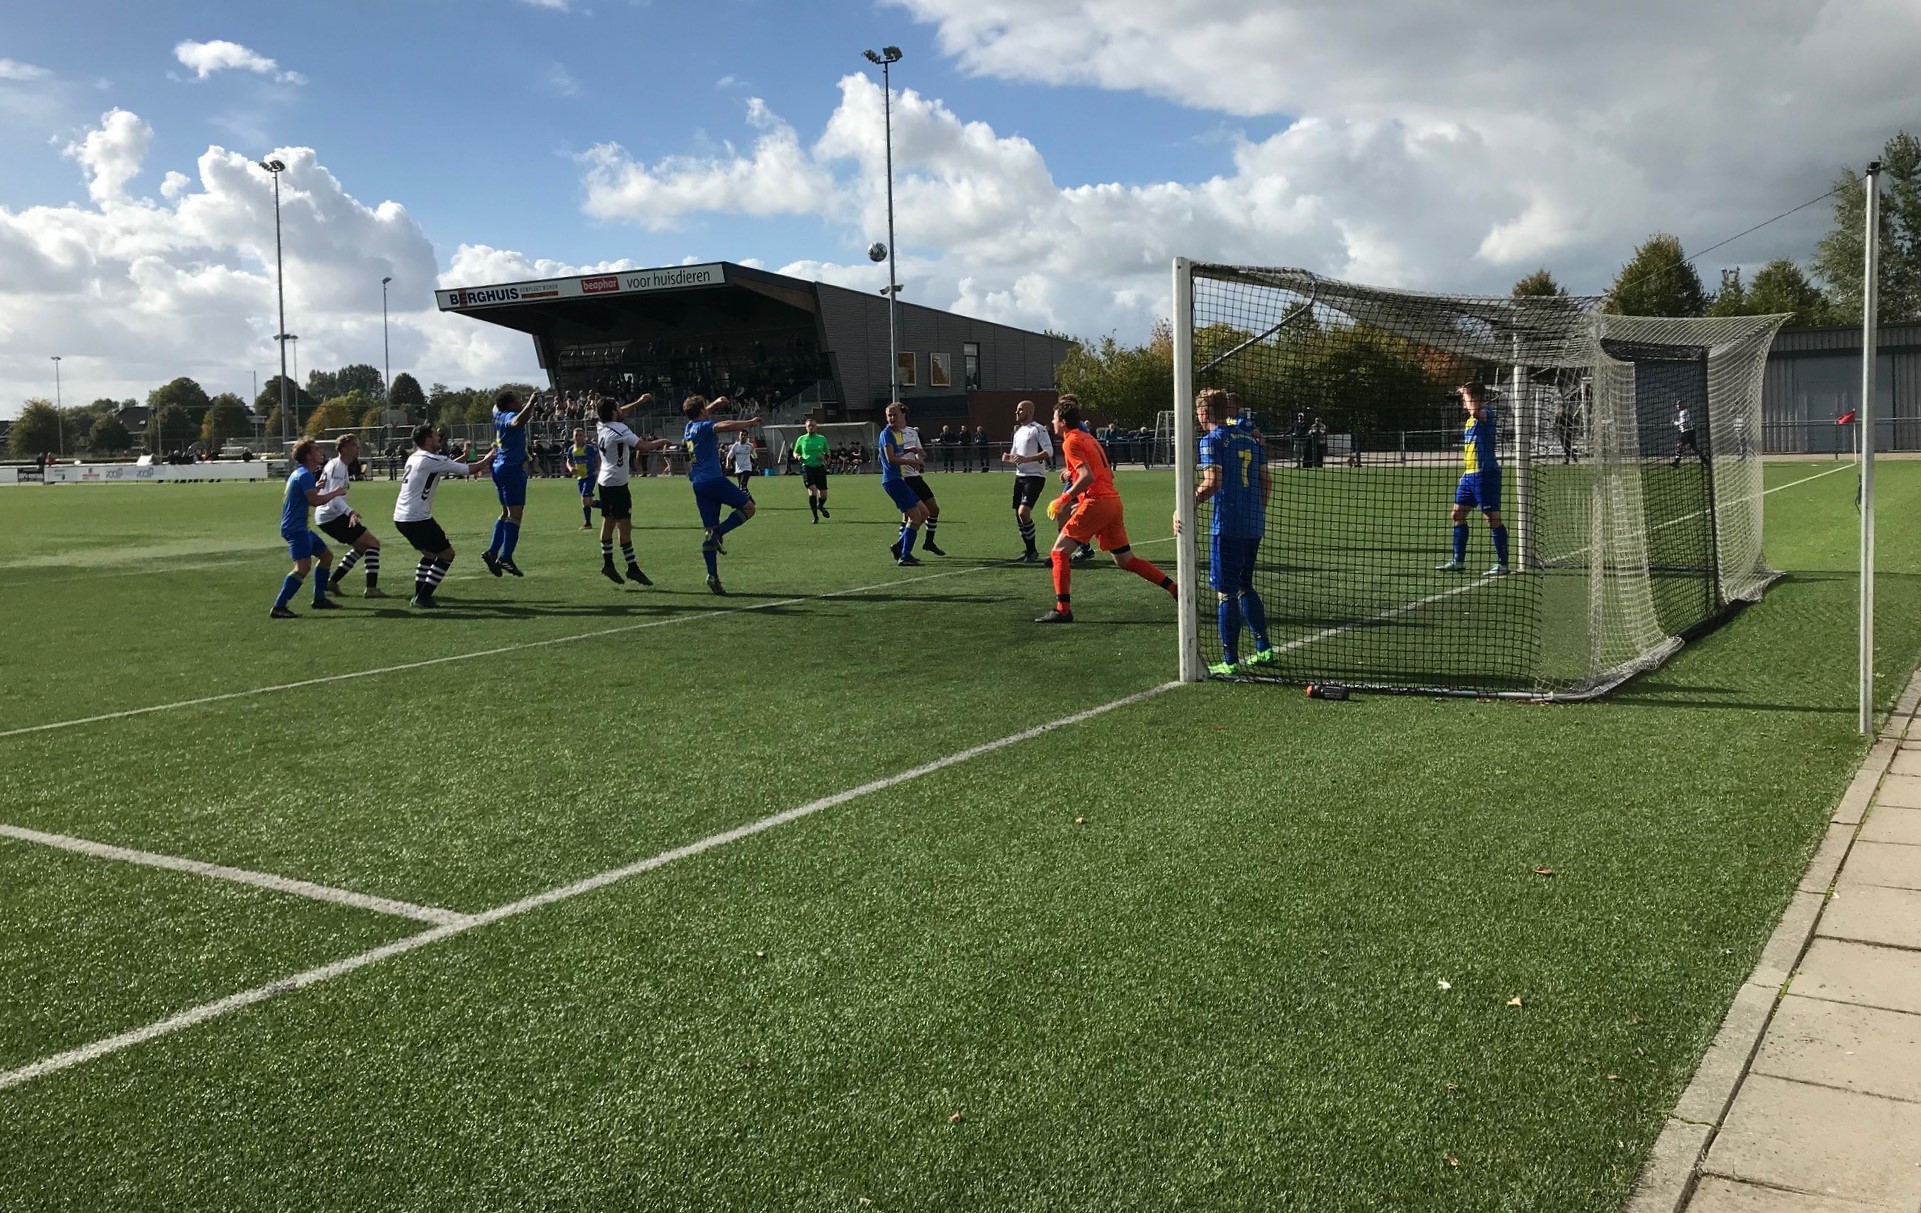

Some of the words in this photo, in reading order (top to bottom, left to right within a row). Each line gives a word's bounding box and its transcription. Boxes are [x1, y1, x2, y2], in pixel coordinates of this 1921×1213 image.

[582, 278, 617, 291] beaphar
[627, 276, 651, 289] voor
[653, 270, 711, 286] huisdieren
[449, 287, 520, 305] BERGHUIS
[402, 464, 413, 484] 2
[1238, 448, 1252, 488] 7
